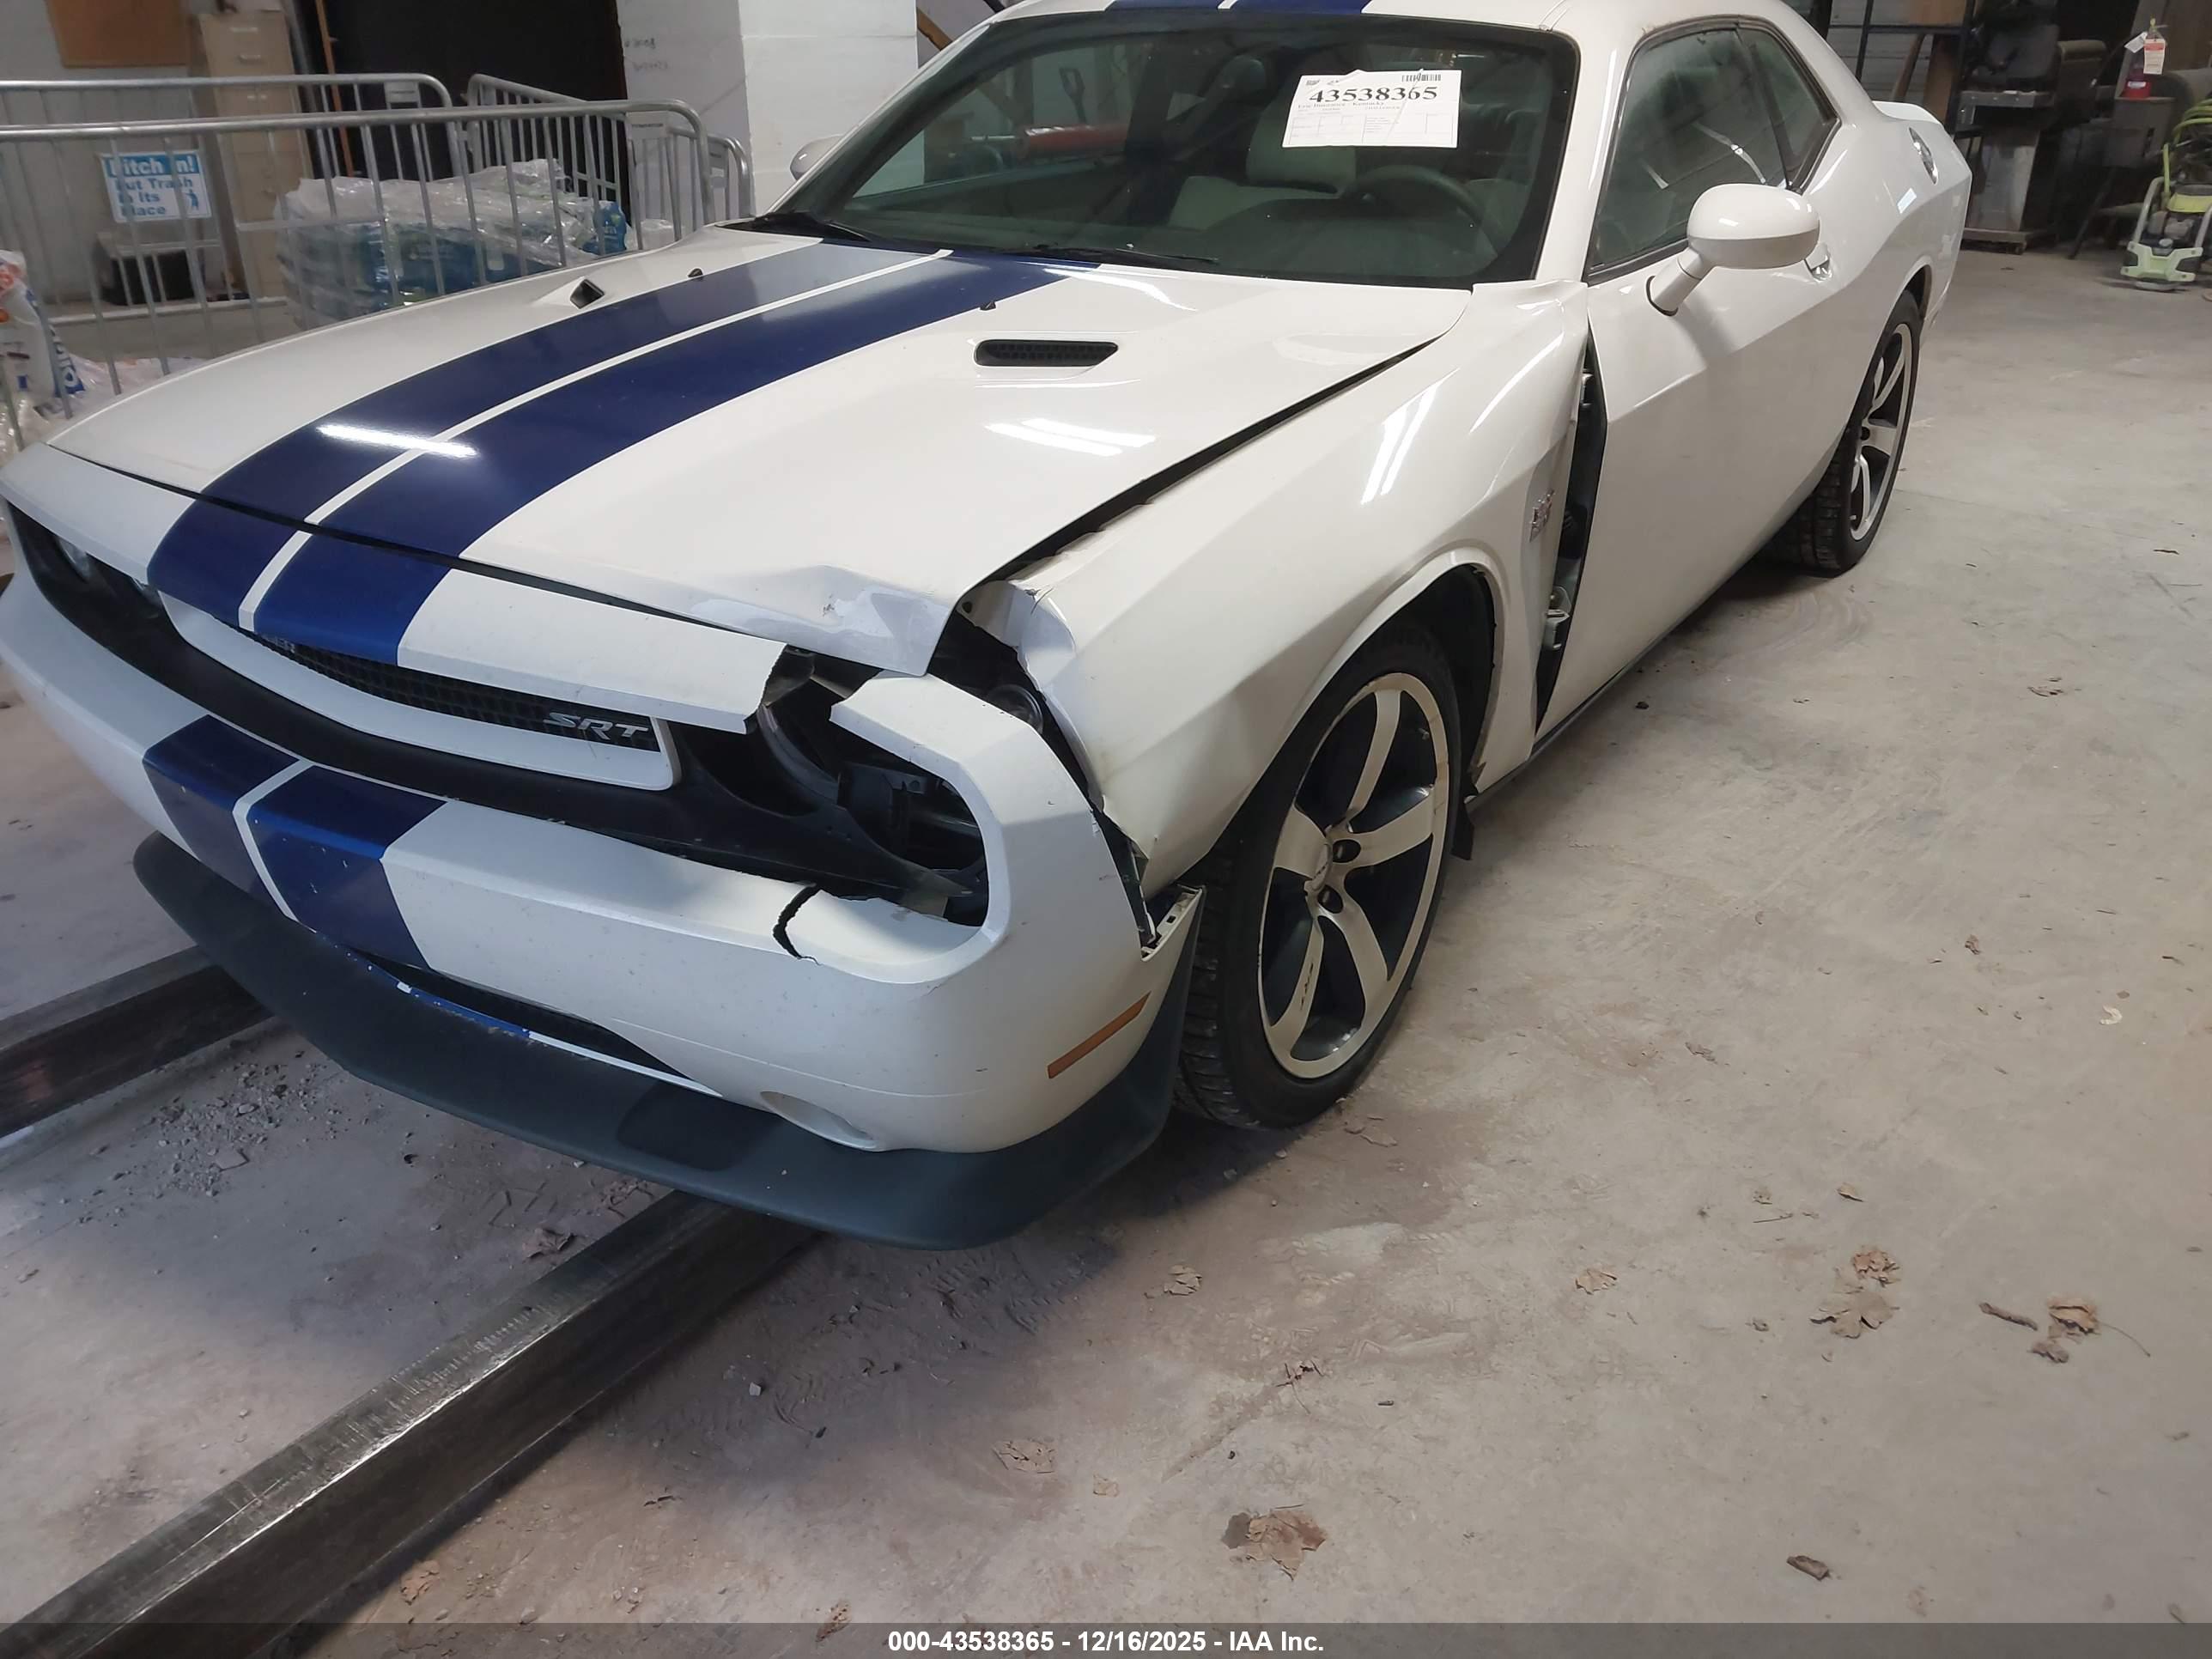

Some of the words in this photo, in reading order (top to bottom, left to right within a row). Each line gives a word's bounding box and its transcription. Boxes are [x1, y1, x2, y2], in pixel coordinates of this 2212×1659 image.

[1309, 87, 1437, 102] 43538365
[137, 191, 161, 204] Its
[544, 712, 649, 740] SRT
